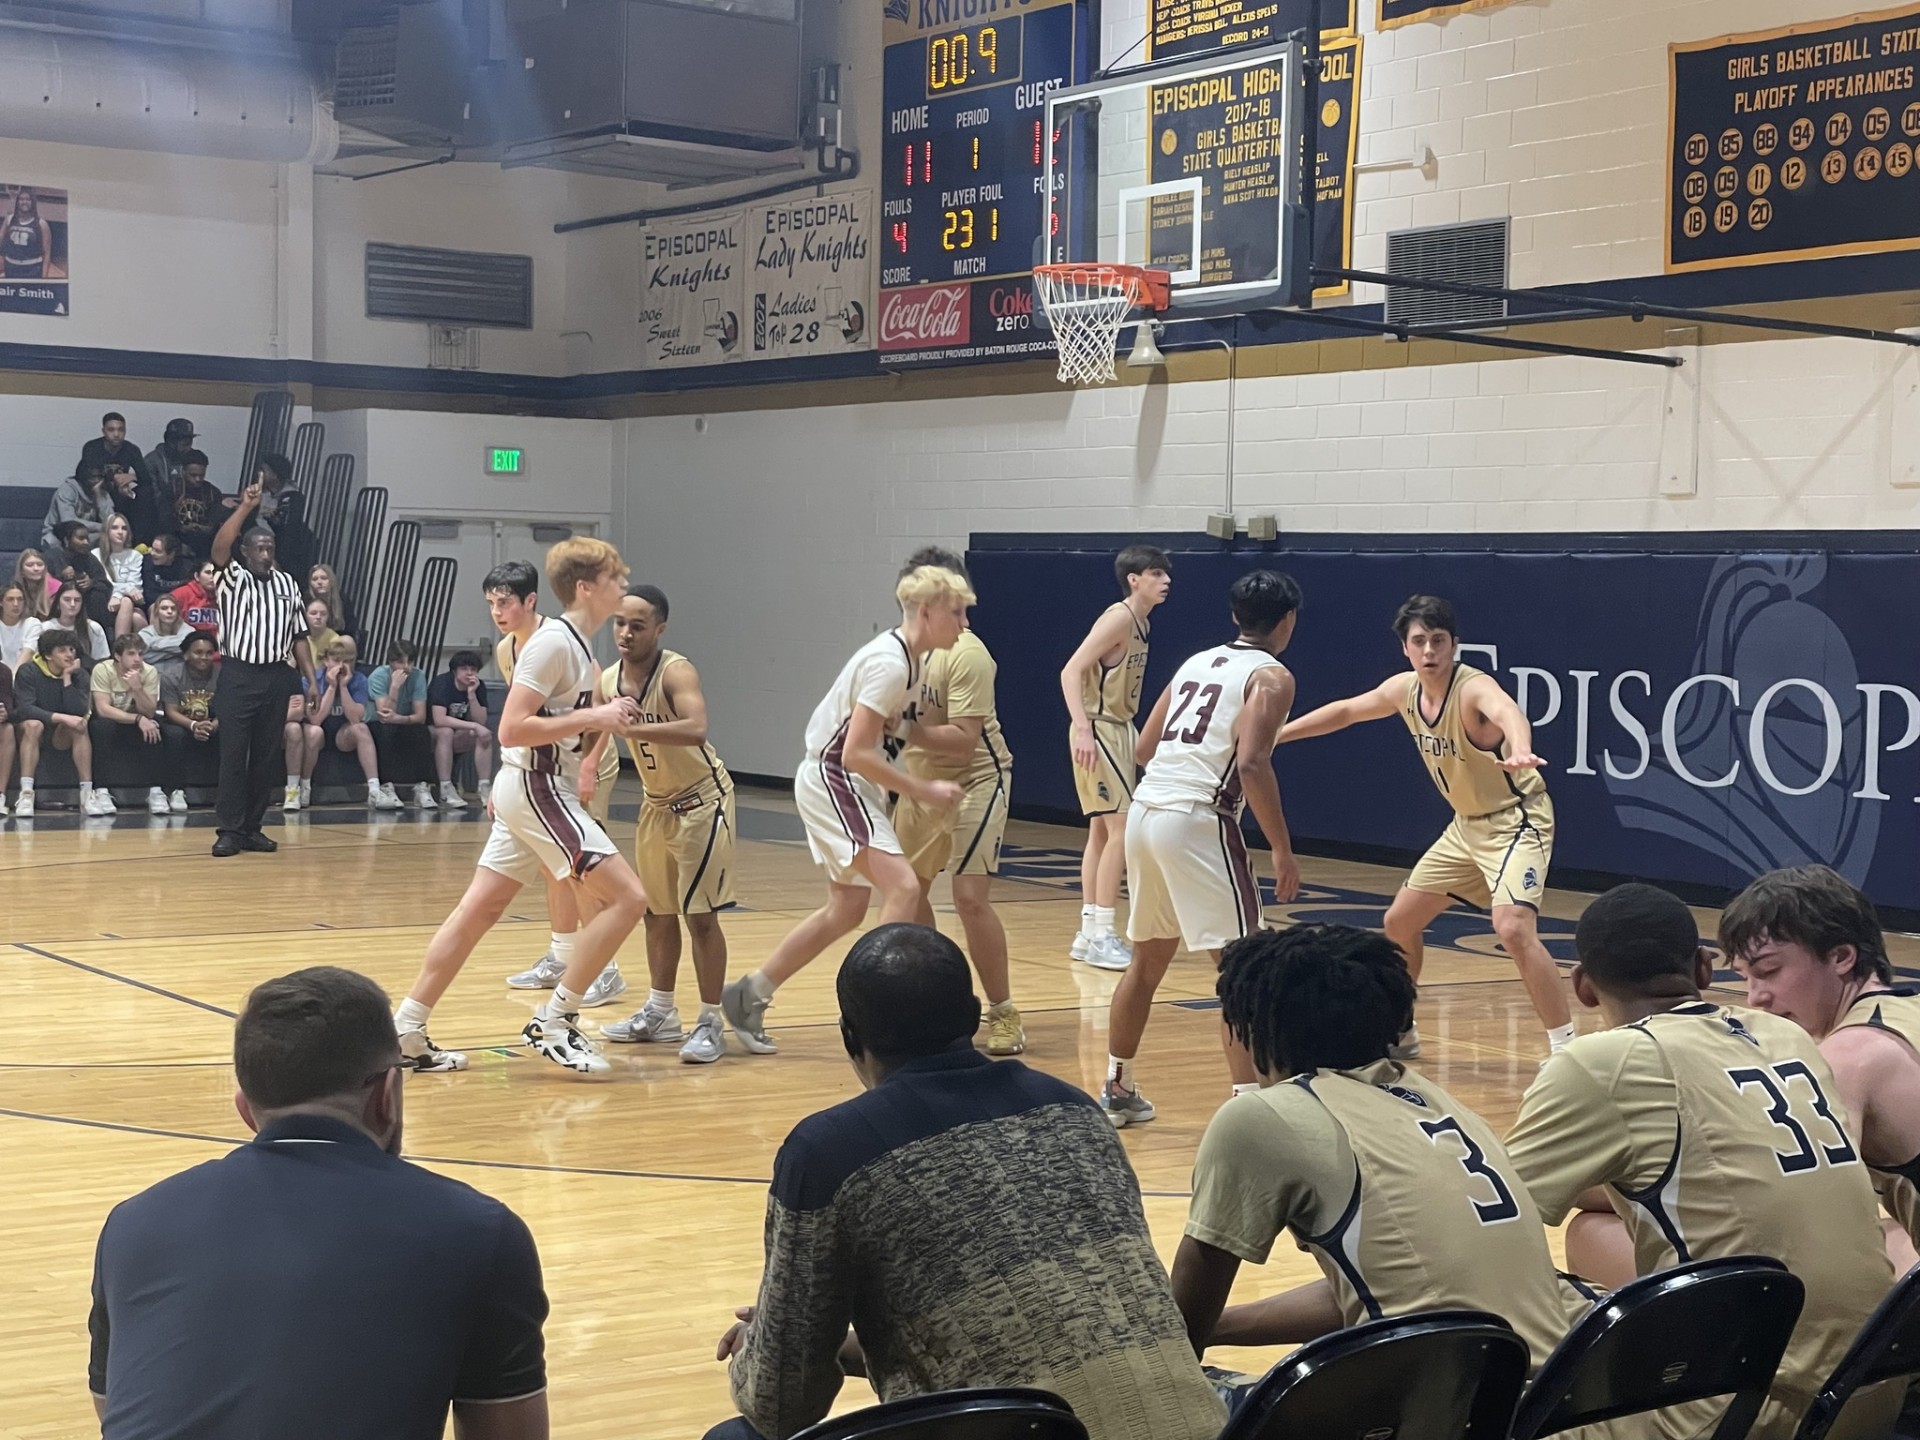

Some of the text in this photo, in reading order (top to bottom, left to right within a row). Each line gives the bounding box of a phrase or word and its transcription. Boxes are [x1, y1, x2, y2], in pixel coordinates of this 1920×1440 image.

[1727, 54, 1769, 80] GIRLS
[1776, 37, 1872, 73] BASKETBALL
[1153, 76, 1237, 115] EPISCOPAL
[1243, 68, 1281, 98] HIGH
[1734, 66, 1914, 114] PLAYOFF APPEARANCES
[891, 105, 929, 134] HOME
[956, 107, 989, 129] PERIOD
[1225, 97, 1271, 124] 2017-18
[1196, 117, 1281, 150] GIRLS BASKETB
[1687, 139, 1706, 160] 80
[1721, 133, 1740, 156] 85
[1756, 128, 1776, 150] 88
[1792, 121, 1811, 146] 94
[1828, 118, 1848, 141] 04
[1866, 112, 1887, 135] 05
[906, 140, 932, 186] 11
[972, 137, 979, 170] 1
[1183, 138, 1281, 173] STATE QUARTERFIN
[1034, 172, 1065, 194] FOLS
[1223, 179, 1247, 193] HUNTER
[1687, 151, 1907, 199] 08 09 11 12 13 14 15
[884, 198, 912, 217] FOULS
[941, 184, 1004, 208] PLAYER FOUL
[766, 202, 859, 234] EPISCOPAL
[1689, 203, 1770, 233] 18 19 20
[645, 227, 738, 261] EPISCOPAL
[893, 221, 908, 253] 4
[754, 226, 868, 279] Lady Knights
[953, 256, 986, 275] MATCH
[649, 257, 731, 292] Knights
[883, 267, 911, 285] SCORE
[18, 287, 55, 299] Smith
[639, 308, 663, 323] 2006
[996, 314, 1030, 332] zero
[647, 324, 681, 343] Sweet
[790, 321, 820, 344] 28
[659, 341, 701, 360] Sixteen
[879, 339, 1058, 364] SCOREBOARD PROUDLY PROVIDED BY BATON ROUGE COCA-CO
[494, 449, 520, 472] EXIT
[1161, 680, 1223, 745] 23
[1454, 643, 1920, 803] PISCOP
[640, 743, 656, 770] 5
[1724, 1059, 1859, 1177] 33
[1415, 1114, 1521, 1227] 3
